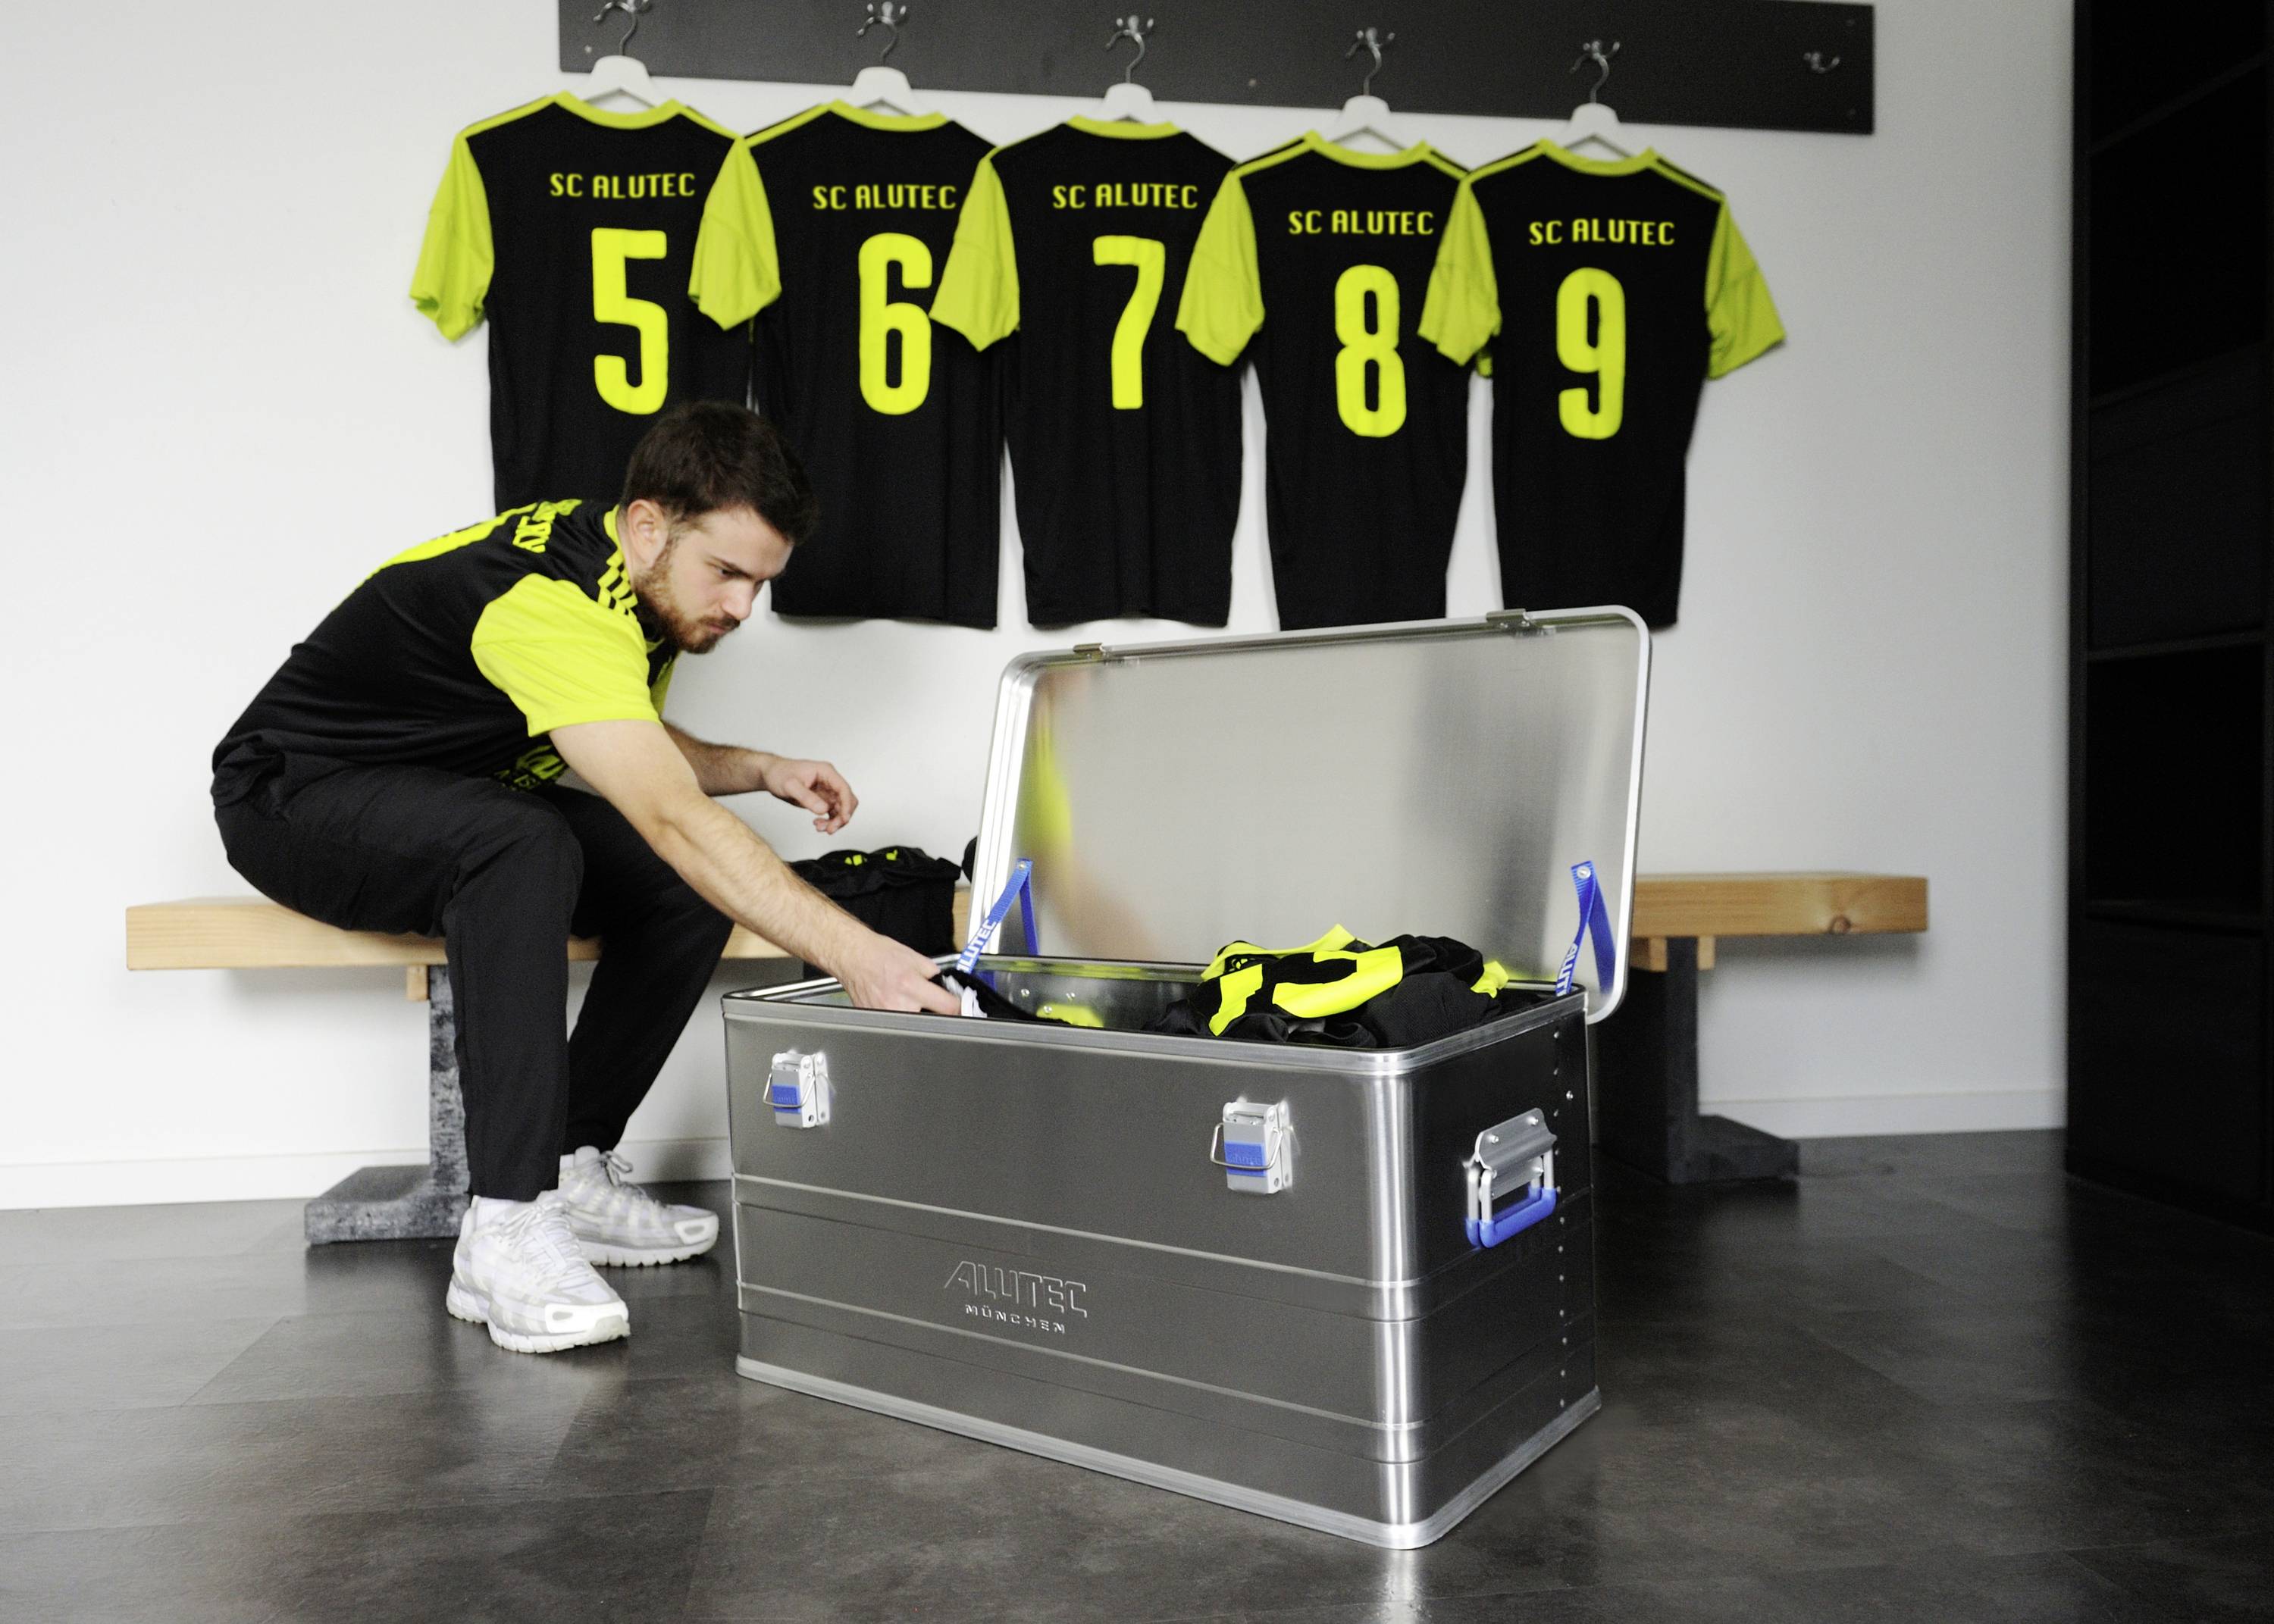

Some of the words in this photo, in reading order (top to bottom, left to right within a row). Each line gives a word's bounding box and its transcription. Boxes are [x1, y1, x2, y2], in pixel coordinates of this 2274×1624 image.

[550, 172, 583, 198] SC
[591, 172, 696, 200] ALUTEC
[812, 185, 847, 211] SC
[854, 183, 957, 210] ALUTEC
[1051, 184, 1086, 210] SC
[1095, 182, 1198, 210] ALUTEC
[1288, 209, 1323, 236] SC
[1330, 209, 1434, 236] ALUTEC
[1528, 220, 1563, 246] SC
[1571, 217, 1674, 246] ALUTEC
[591, 227, 669, 415] 5
[858, 232, 933, 415] 6
[1092, 235, 1166, 410] 7
[1334, 264, 1407, 438] 8
[1556, 267, 1626, 440] 9
[943, 1259, 1088, 1319] ALUTEC
[964, 1303, 1067, 1335] MÜNCHEN
